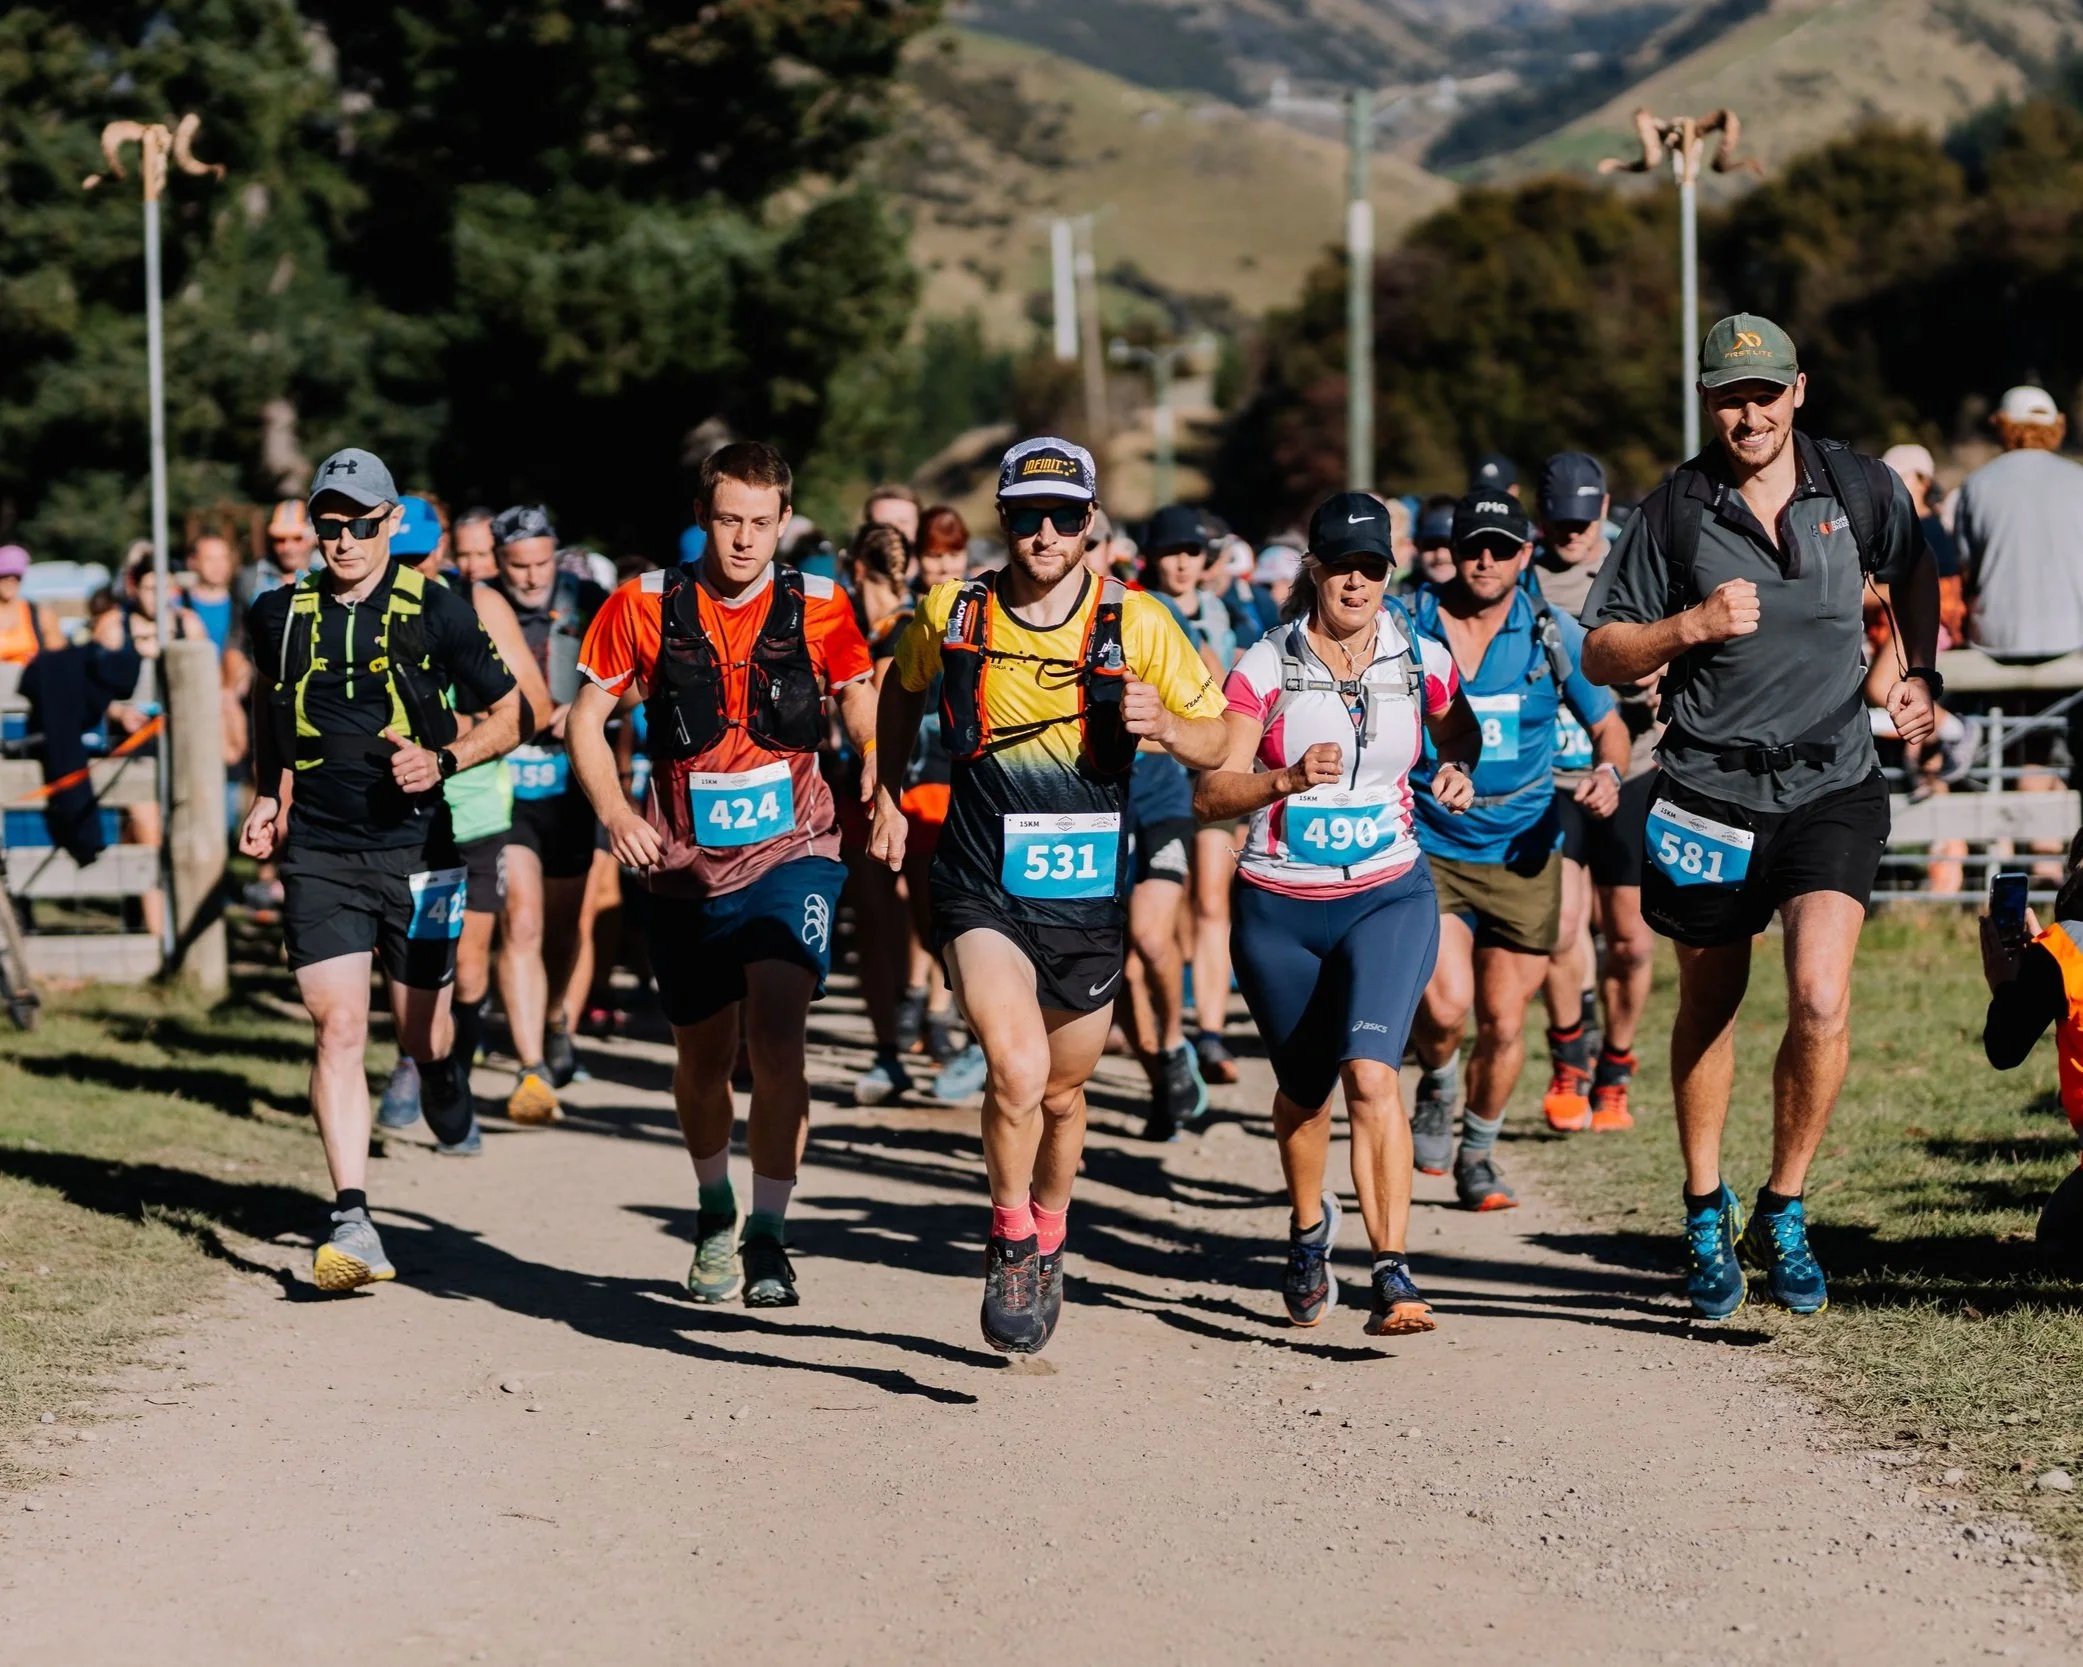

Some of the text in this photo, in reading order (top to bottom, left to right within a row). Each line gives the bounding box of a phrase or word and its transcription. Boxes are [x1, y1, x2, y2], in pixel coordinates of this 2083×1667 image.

[1724, 350, 1773, 358] FIRST LITE
[709, 791, 780, 830] 424
[1660, 807, 1676, 819] 15KM
[1019, 820, 1040, 828] 15KM
[1303, 816, 1379, 851] 490
[1023, 843, 1098, 880] 531
[1657, 831, 1724, 883] 581
[1362, 1022, 1388, 1034] asics
